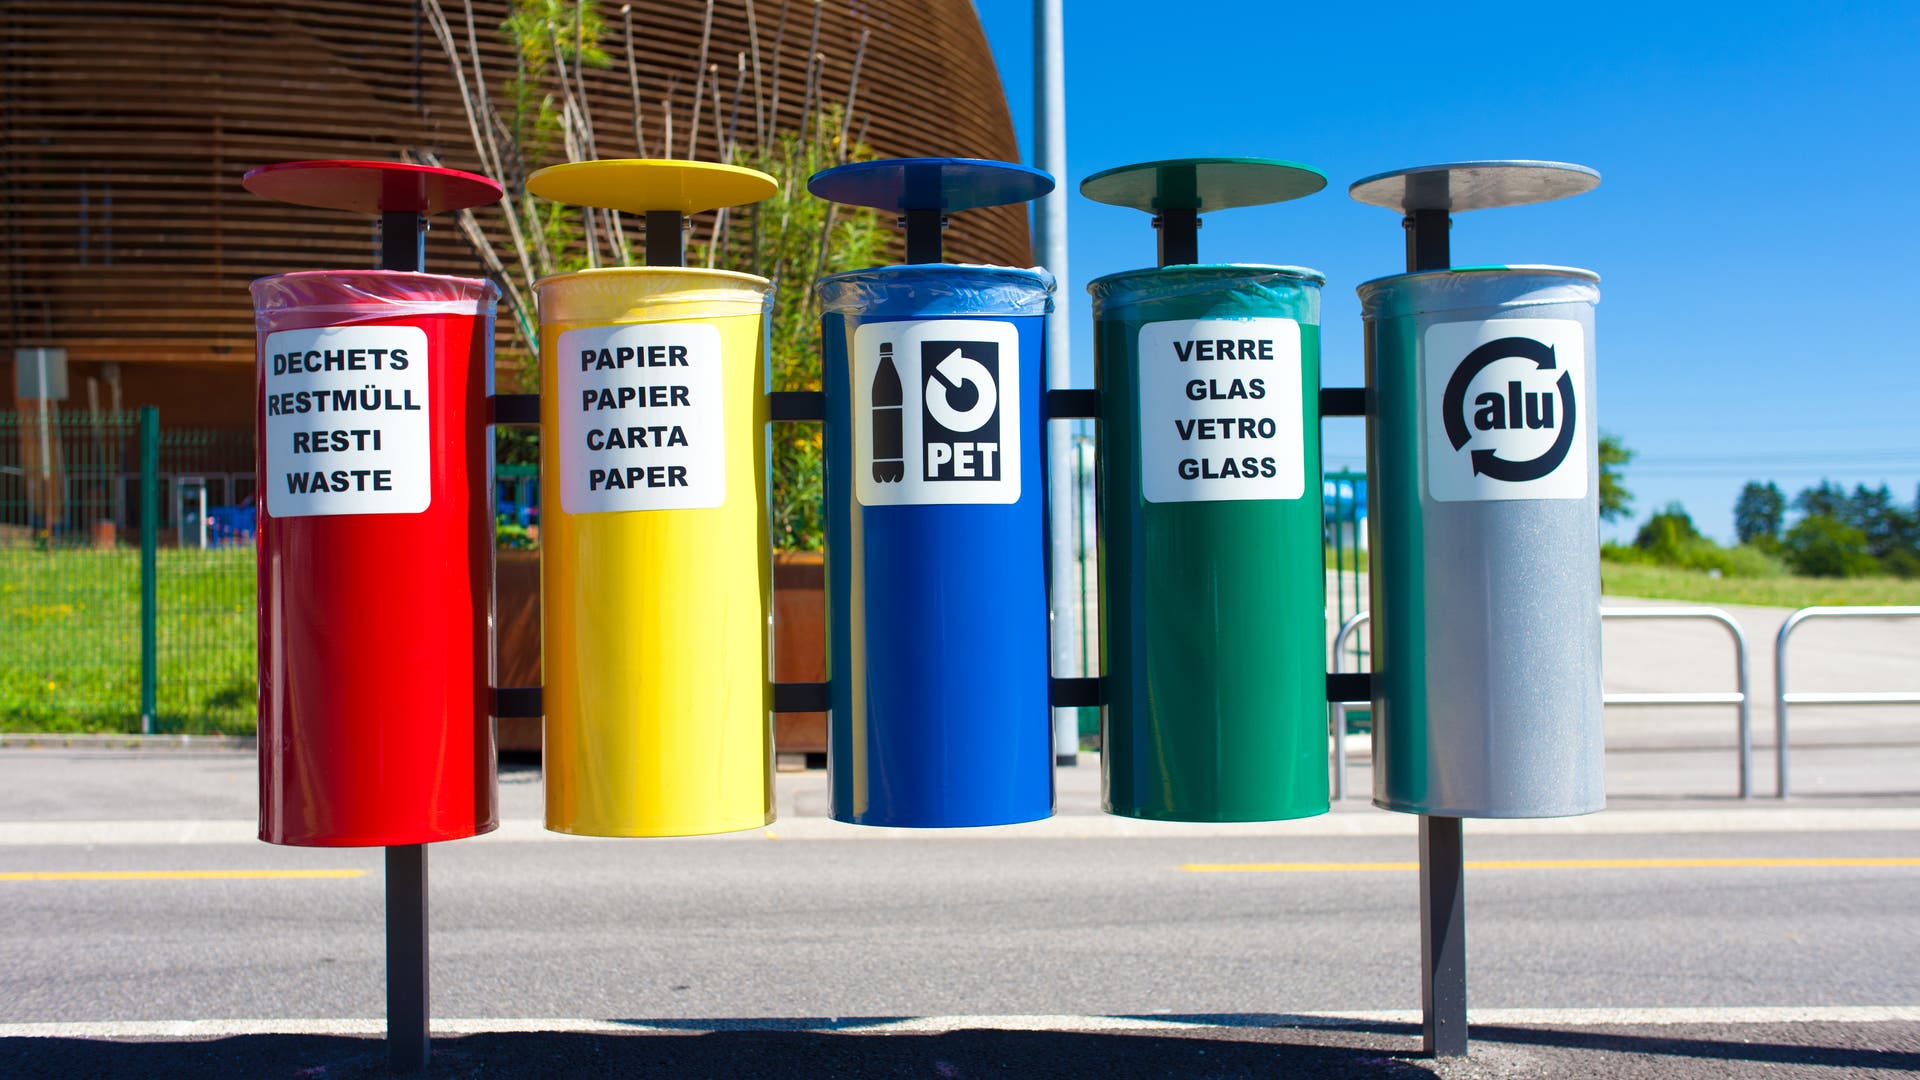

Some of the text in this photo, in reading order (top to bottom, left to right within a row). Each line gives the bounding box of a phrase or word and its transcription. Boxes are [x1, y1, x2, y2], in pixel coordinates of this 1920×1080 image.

[273, 348, 409, 376] DECHETS
[581, 345, 689, 372] PAPIER
[1173, 339, 1274, 363] VERRE
[268, 384, 421, 417] RESTMÜLL
[582, 385, 690, 412] PAPIER
[1185, 378, 1266, 401] GLAS
[1474, 381, 1555, 430] alu
[293, 429, 381, 454] RESTI
[586, 425, 689, 451] CARTA
[1175, 417, 1276, 441] VETRO
[928, 442, 997, 477] PET
[1178, 457, 1277, 480] GLASS
[286, 469, 392, 494] WASTE
[589, 465, 689, 491] PAPER
